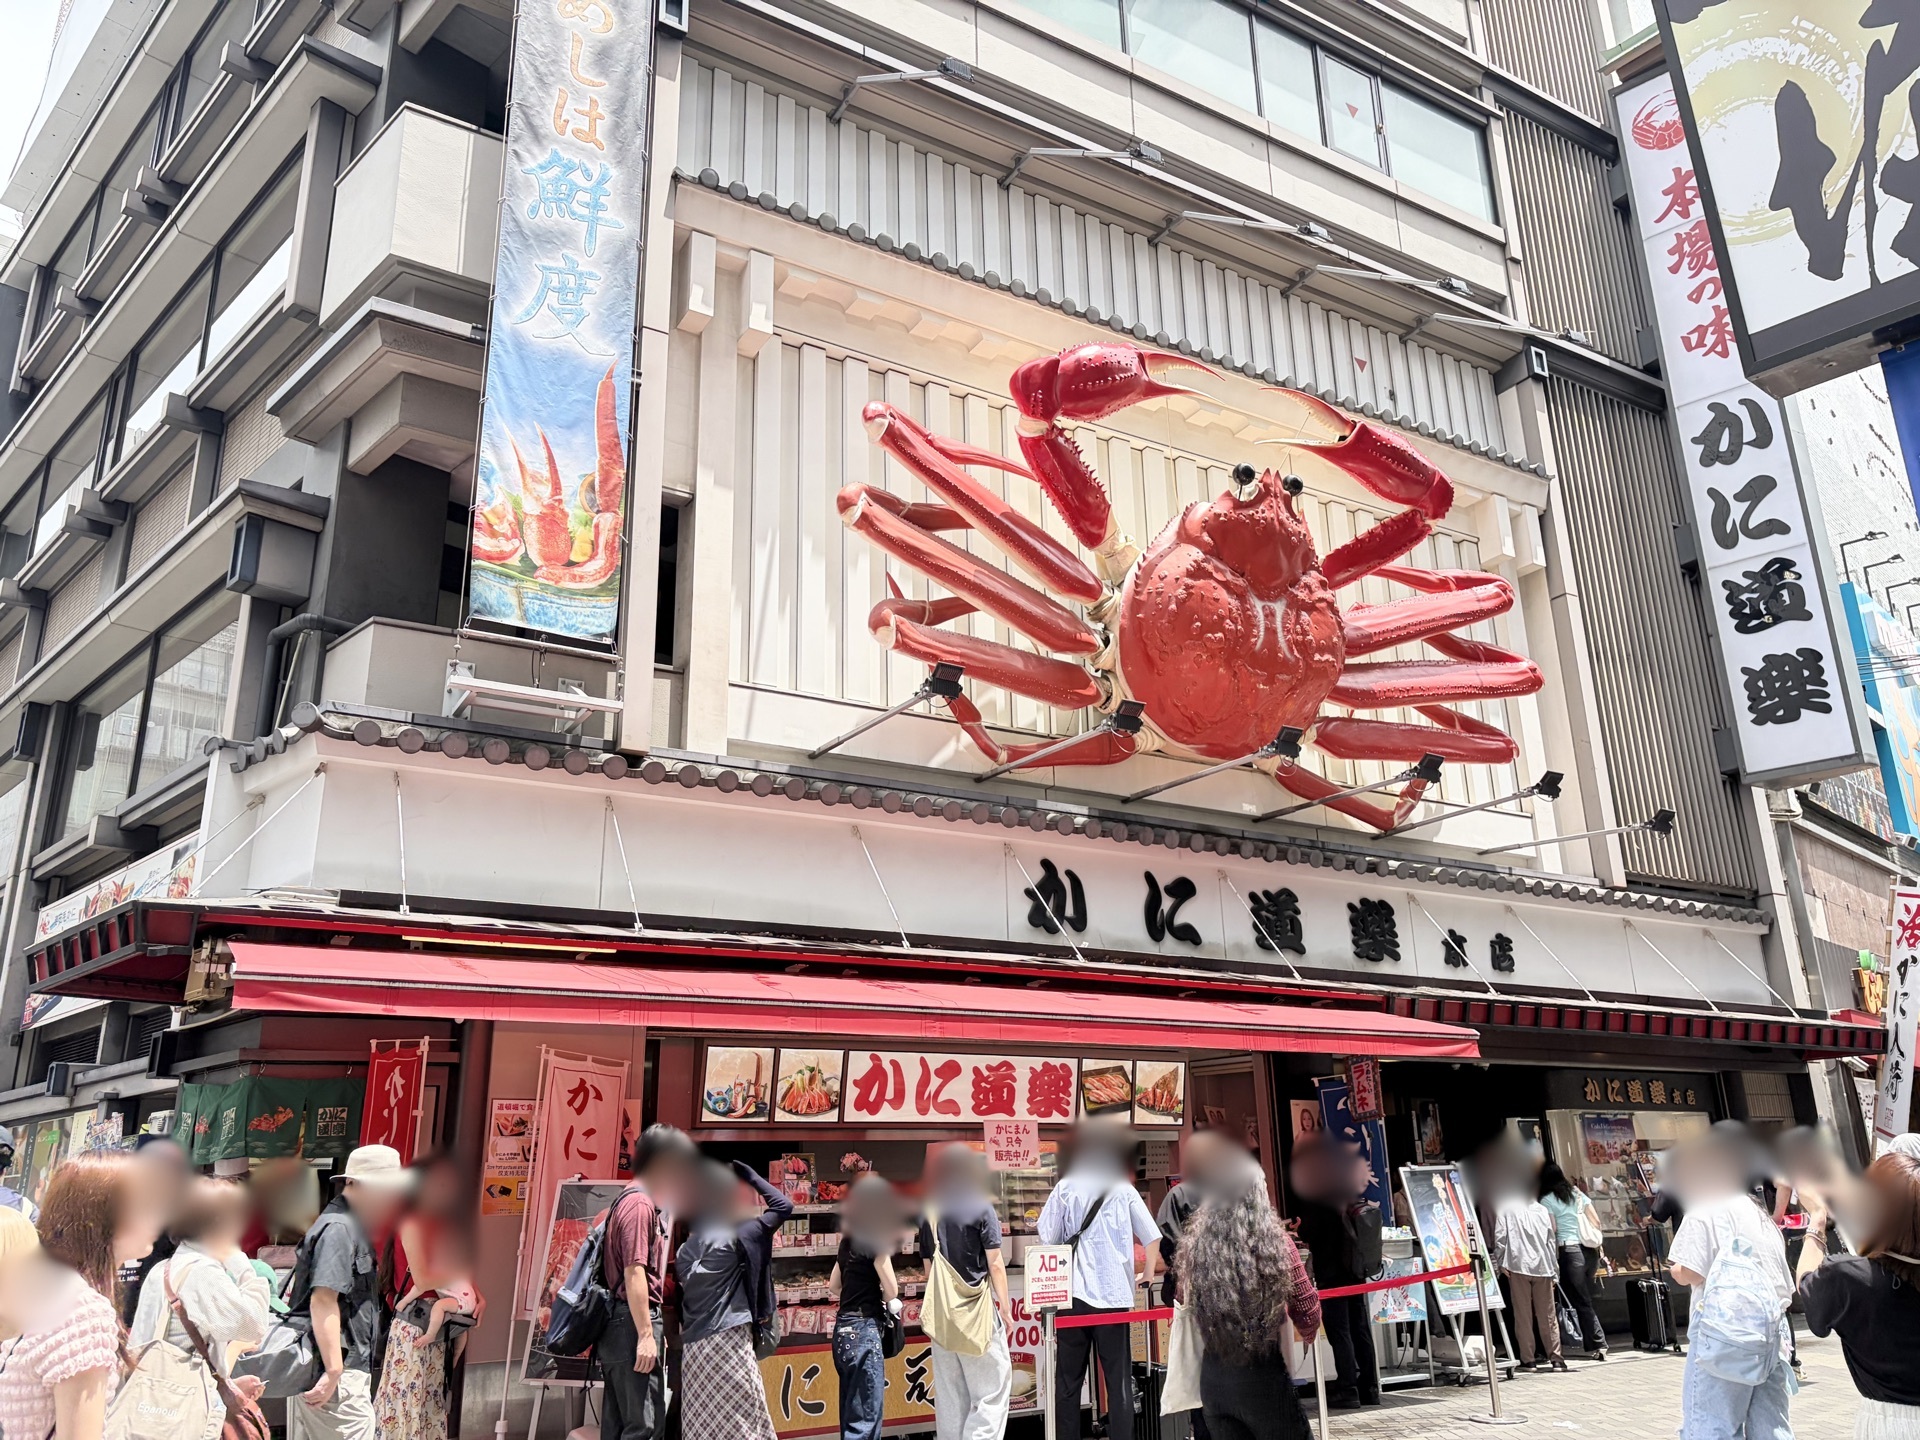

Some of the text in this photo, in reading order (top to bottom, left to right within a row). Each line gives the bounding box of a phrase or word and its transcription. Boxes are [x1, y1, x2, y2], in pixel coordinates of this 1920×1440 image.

[1654, 167, 1737, 359] 本場の味
[1441, 928, 1515, 972] 本店
[1353, 1065, 1369, 1112] ラムネ
[563, 1078, 604, 1179] かに
[995, 1124, 1030, 1135] かにまん
[1006, 1136, 1022, 1147] 只今
[1039, 1254, 1058, 1272] 入口
[138, 1402, 178, 1418] Epanoui
